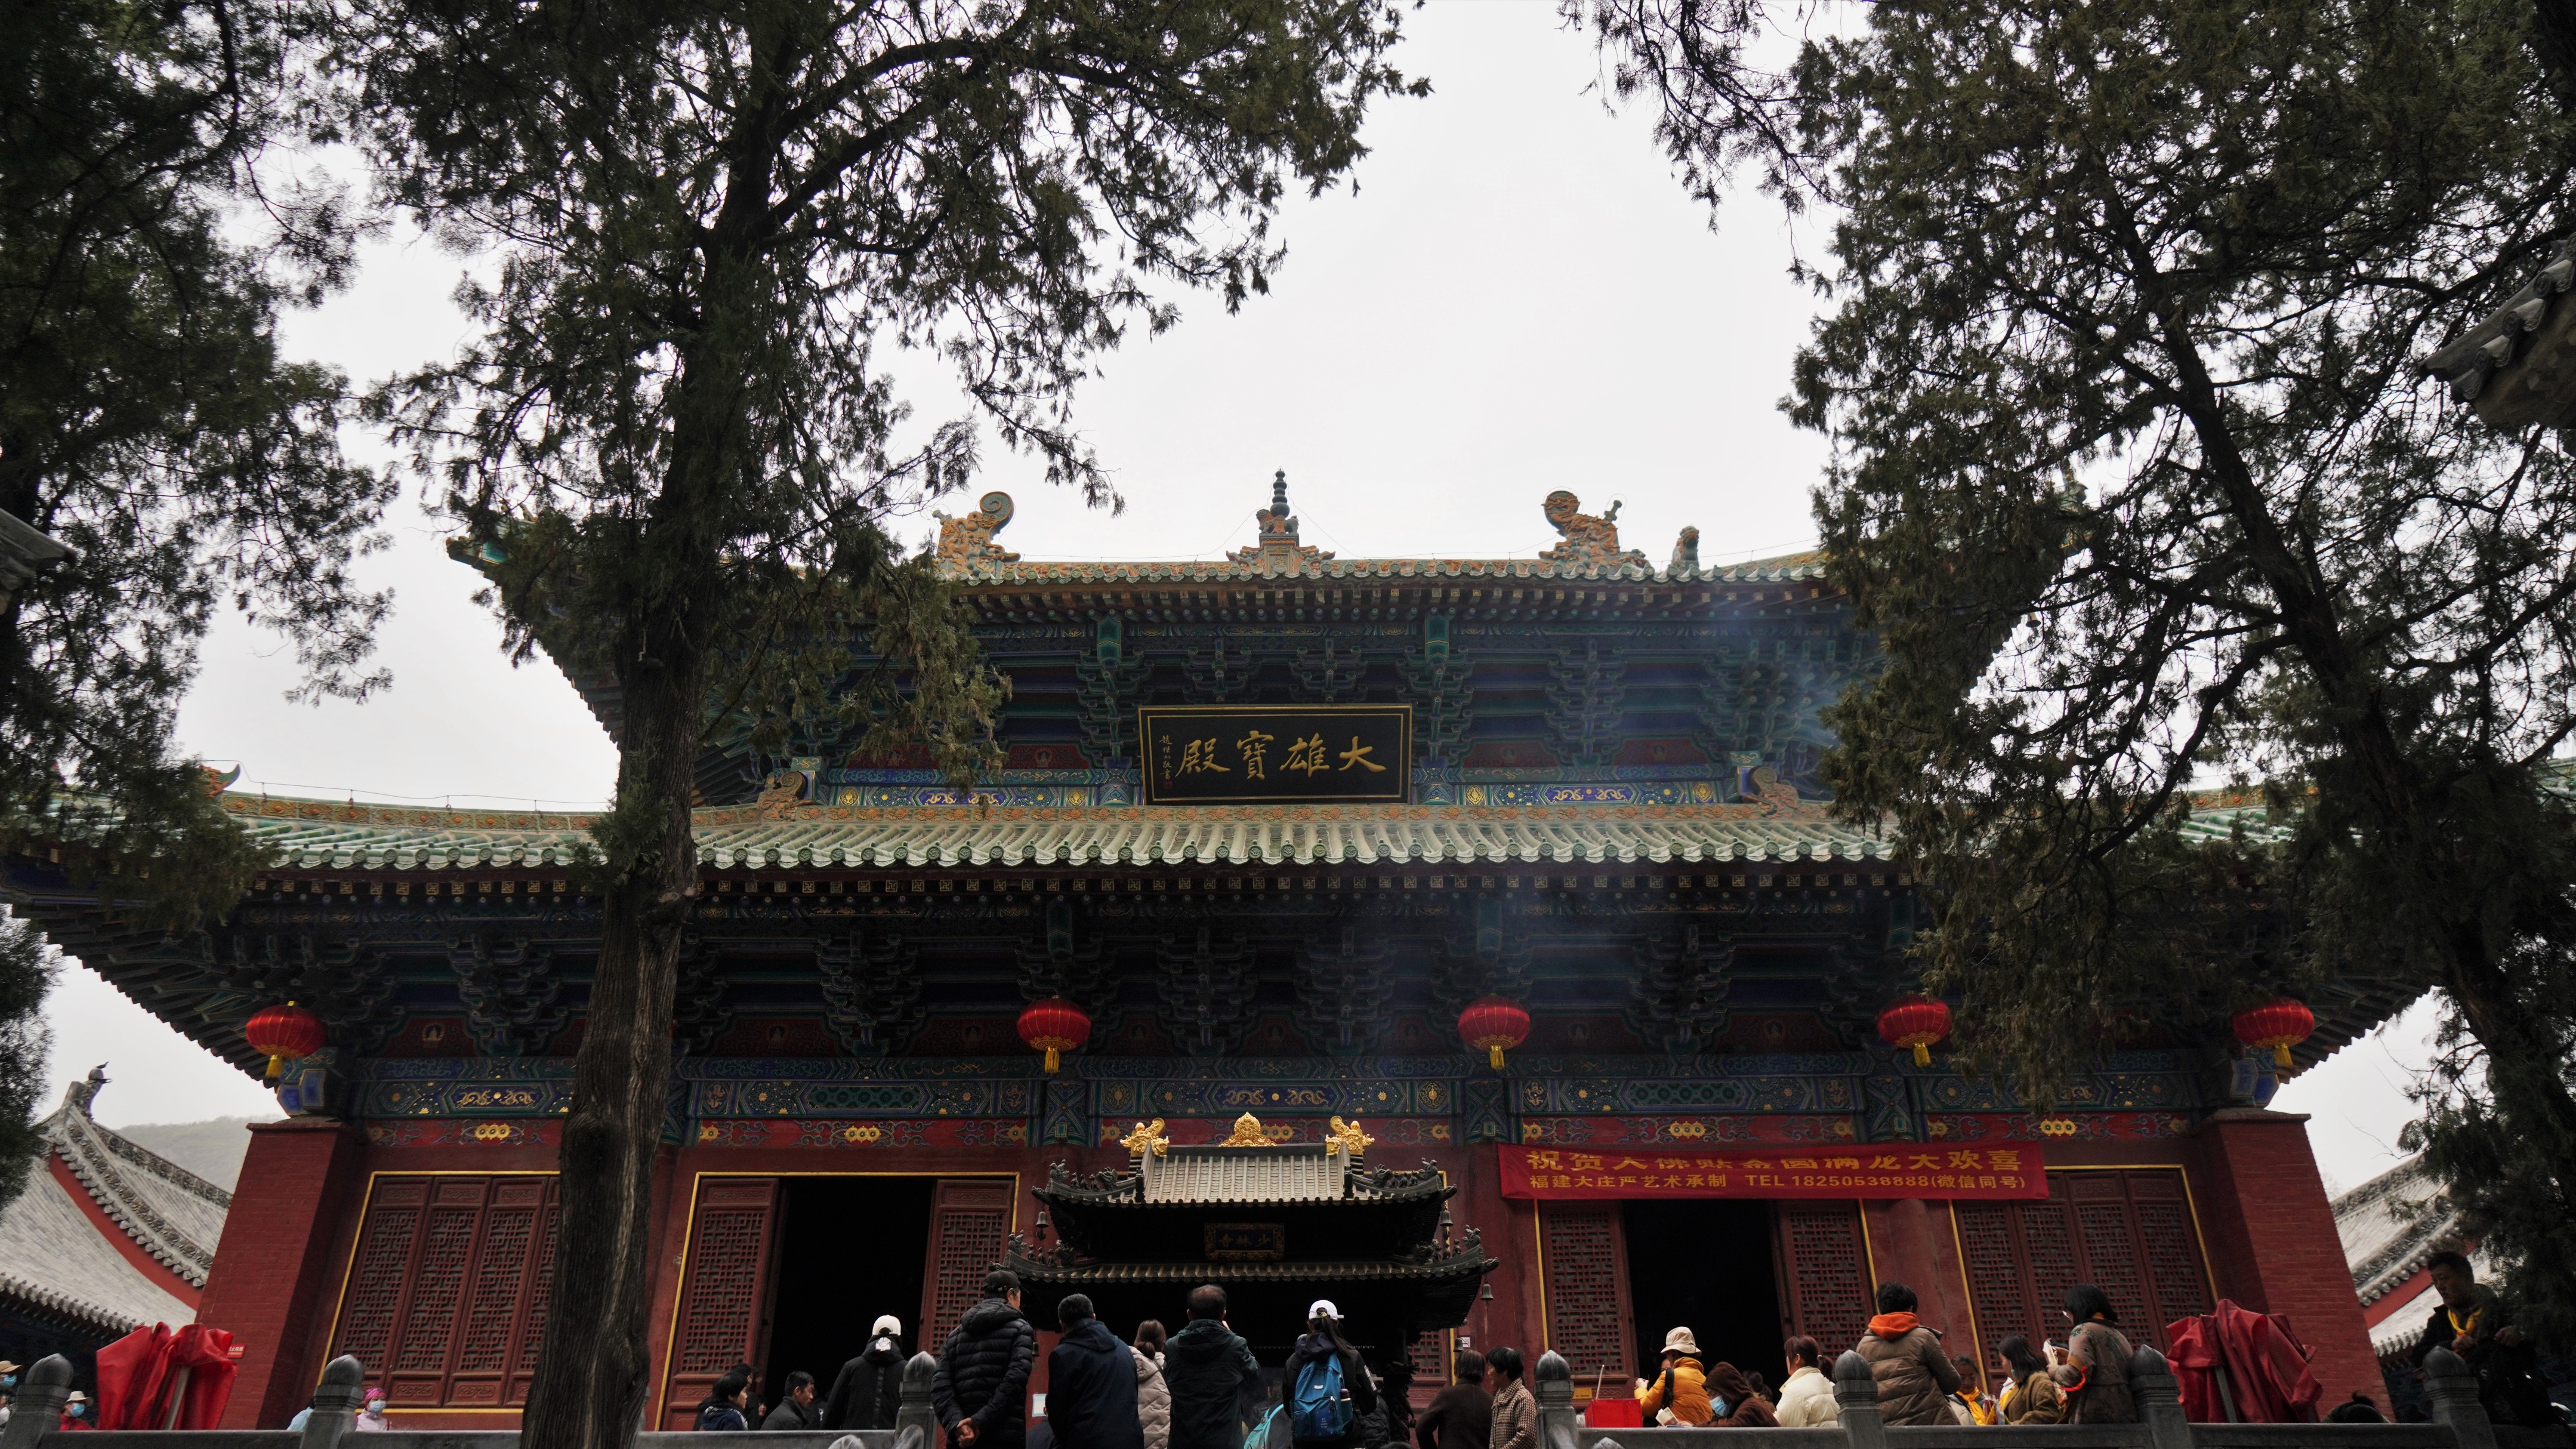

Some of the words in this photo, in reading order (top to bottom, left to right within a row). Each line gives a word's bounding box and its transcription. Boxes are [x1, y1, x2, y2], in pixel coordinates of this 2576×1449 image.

[1175, 730, 1386, 780] 大雄寶殿
[1529, 1174, 1726, 1188] 福建大庄严艺术承制
[1745, 1174, 1785, 1186] TEL
[1218, 1234, 1271, 1248] 少林寺
